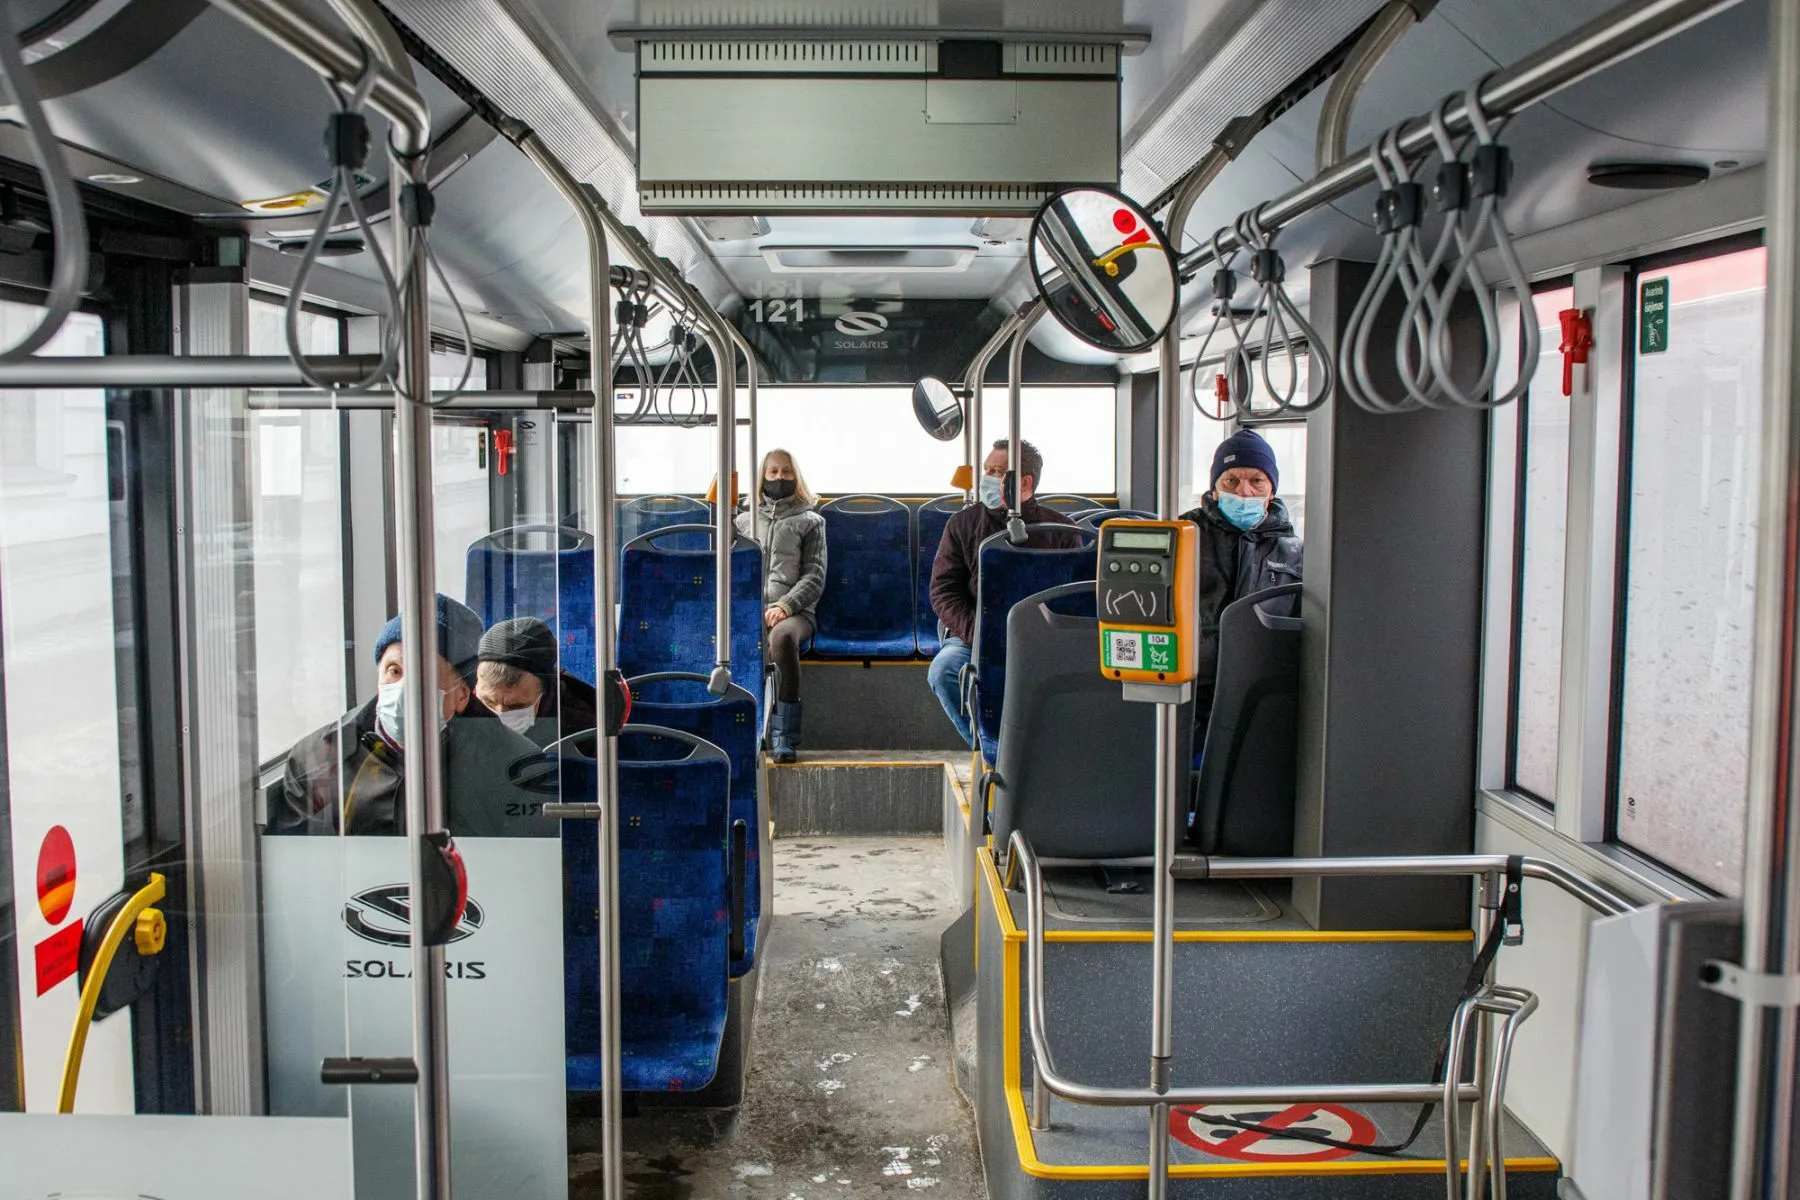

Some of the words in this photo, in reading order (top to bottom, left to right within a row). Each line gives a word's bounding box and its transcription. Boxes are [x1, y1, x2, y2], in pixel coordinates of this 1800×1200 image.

[749, 299, 803, 322] 121
[834, 341, 889, 349] SOLARIS
[1152, 636, 1165, 644] 104
[343, 960, 487, 980] SOLRIS
